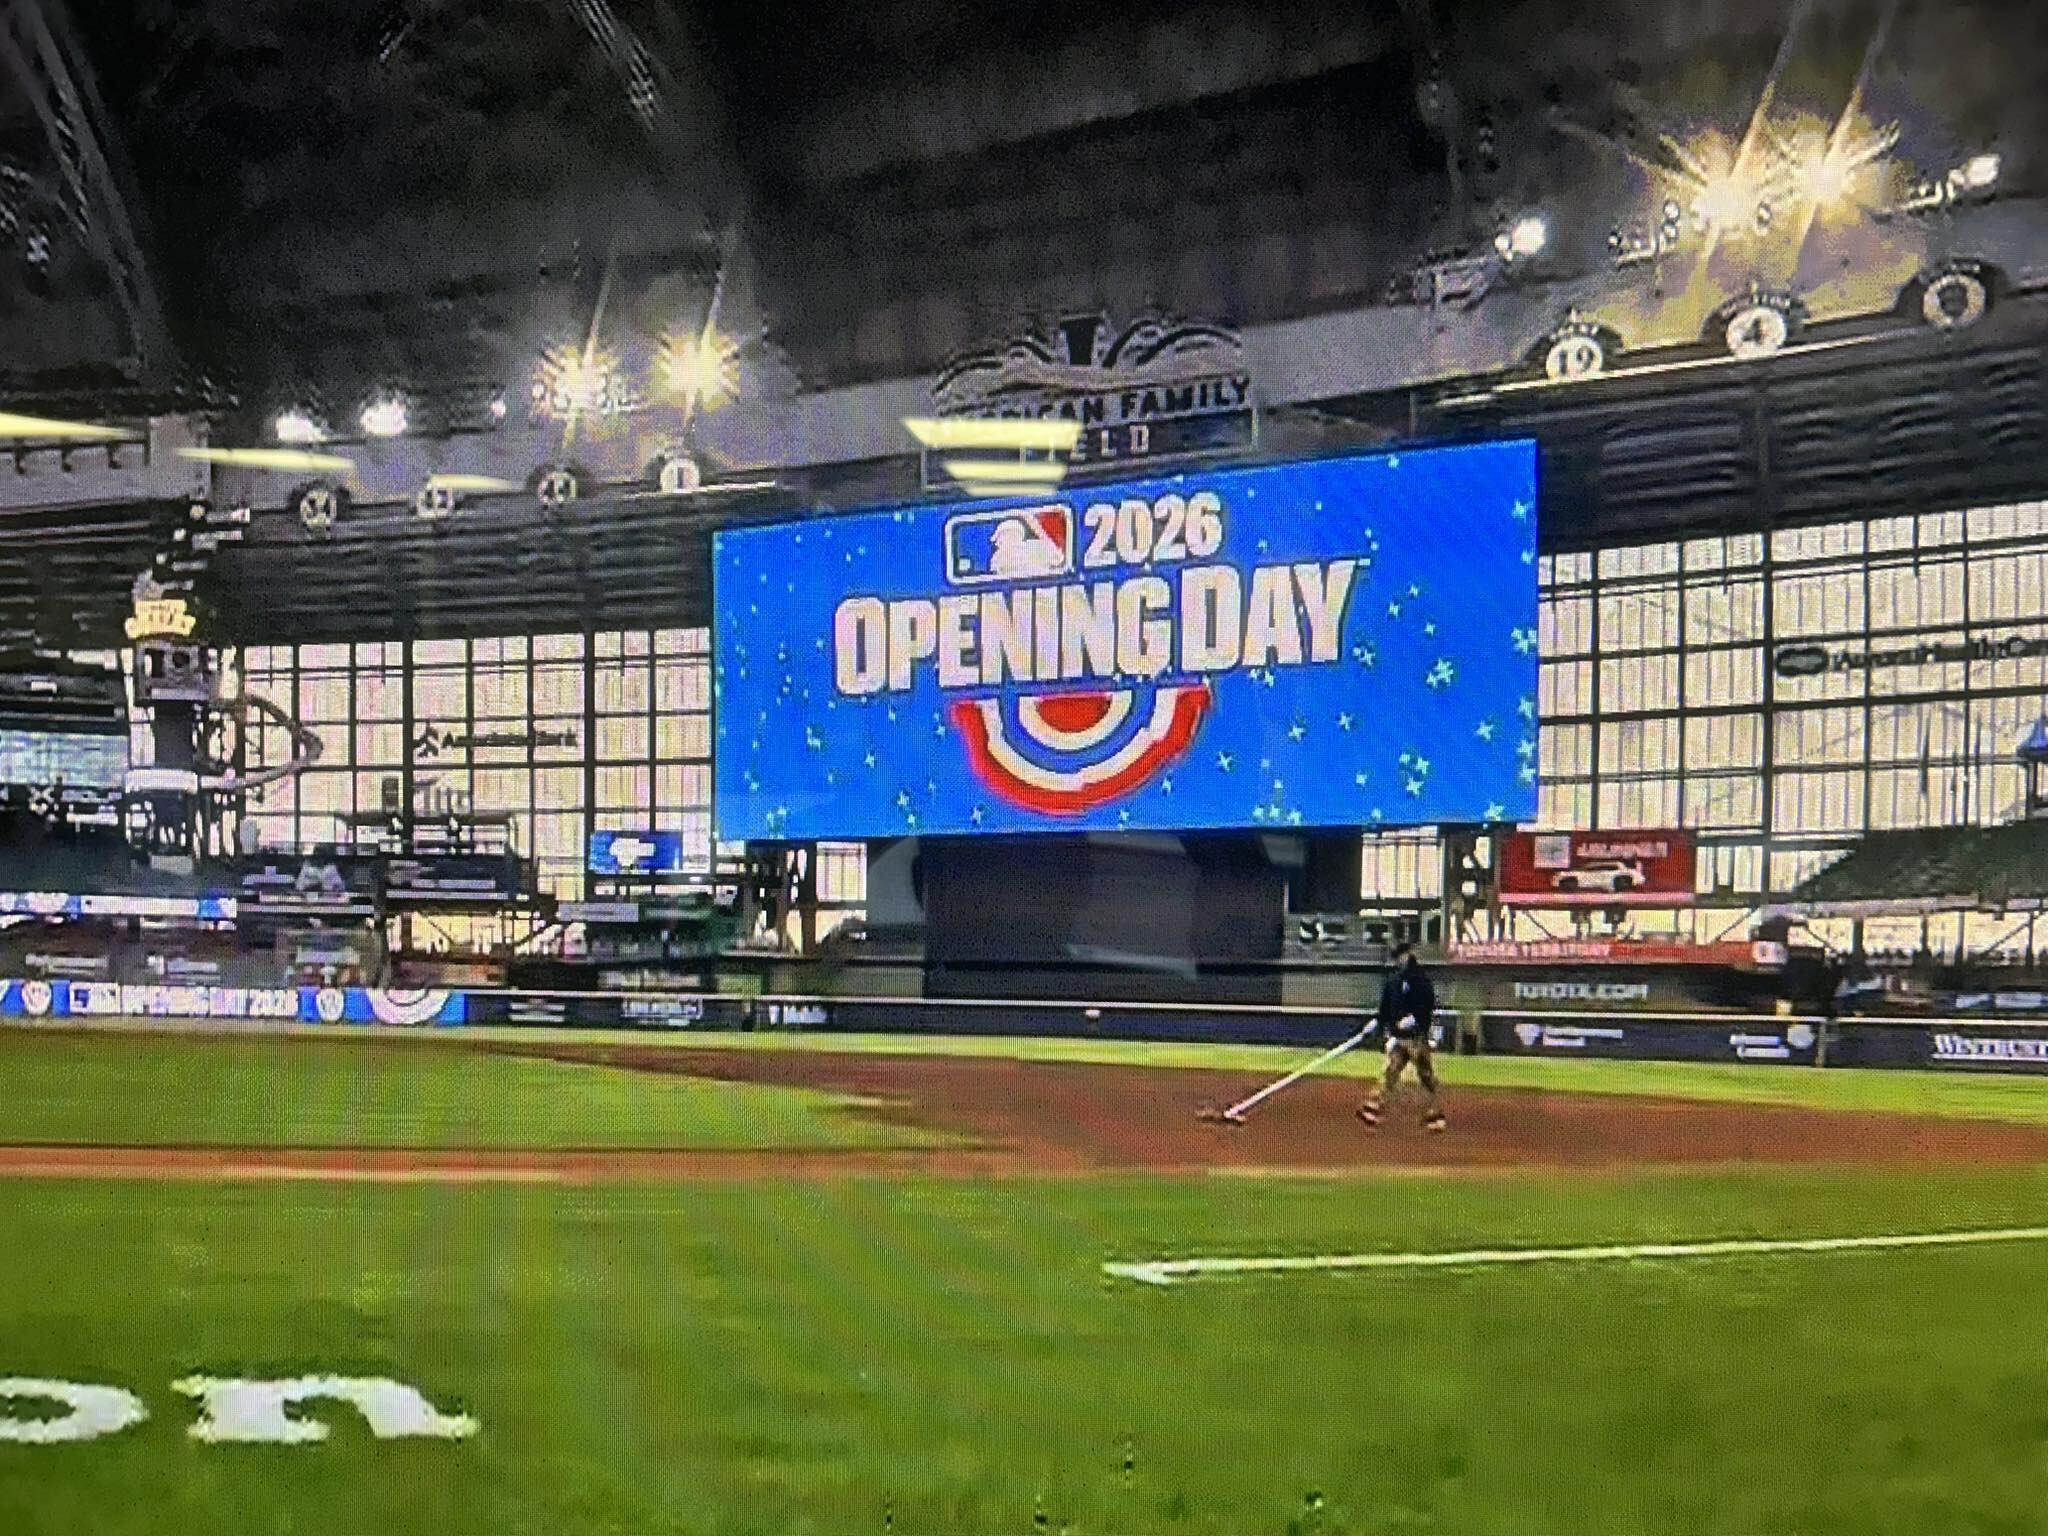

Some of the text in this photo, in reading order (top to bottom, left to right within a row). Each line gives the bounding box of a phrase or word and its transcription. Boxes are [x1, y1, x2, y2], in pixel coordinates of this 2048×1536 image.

[1557, 345, 1595, 376] 19
[1121, 376, 1251, 419] FAMILY
[1083, 491, 1223, 568] 2026
[834, 558, 1358, 698] OPENING DAY
